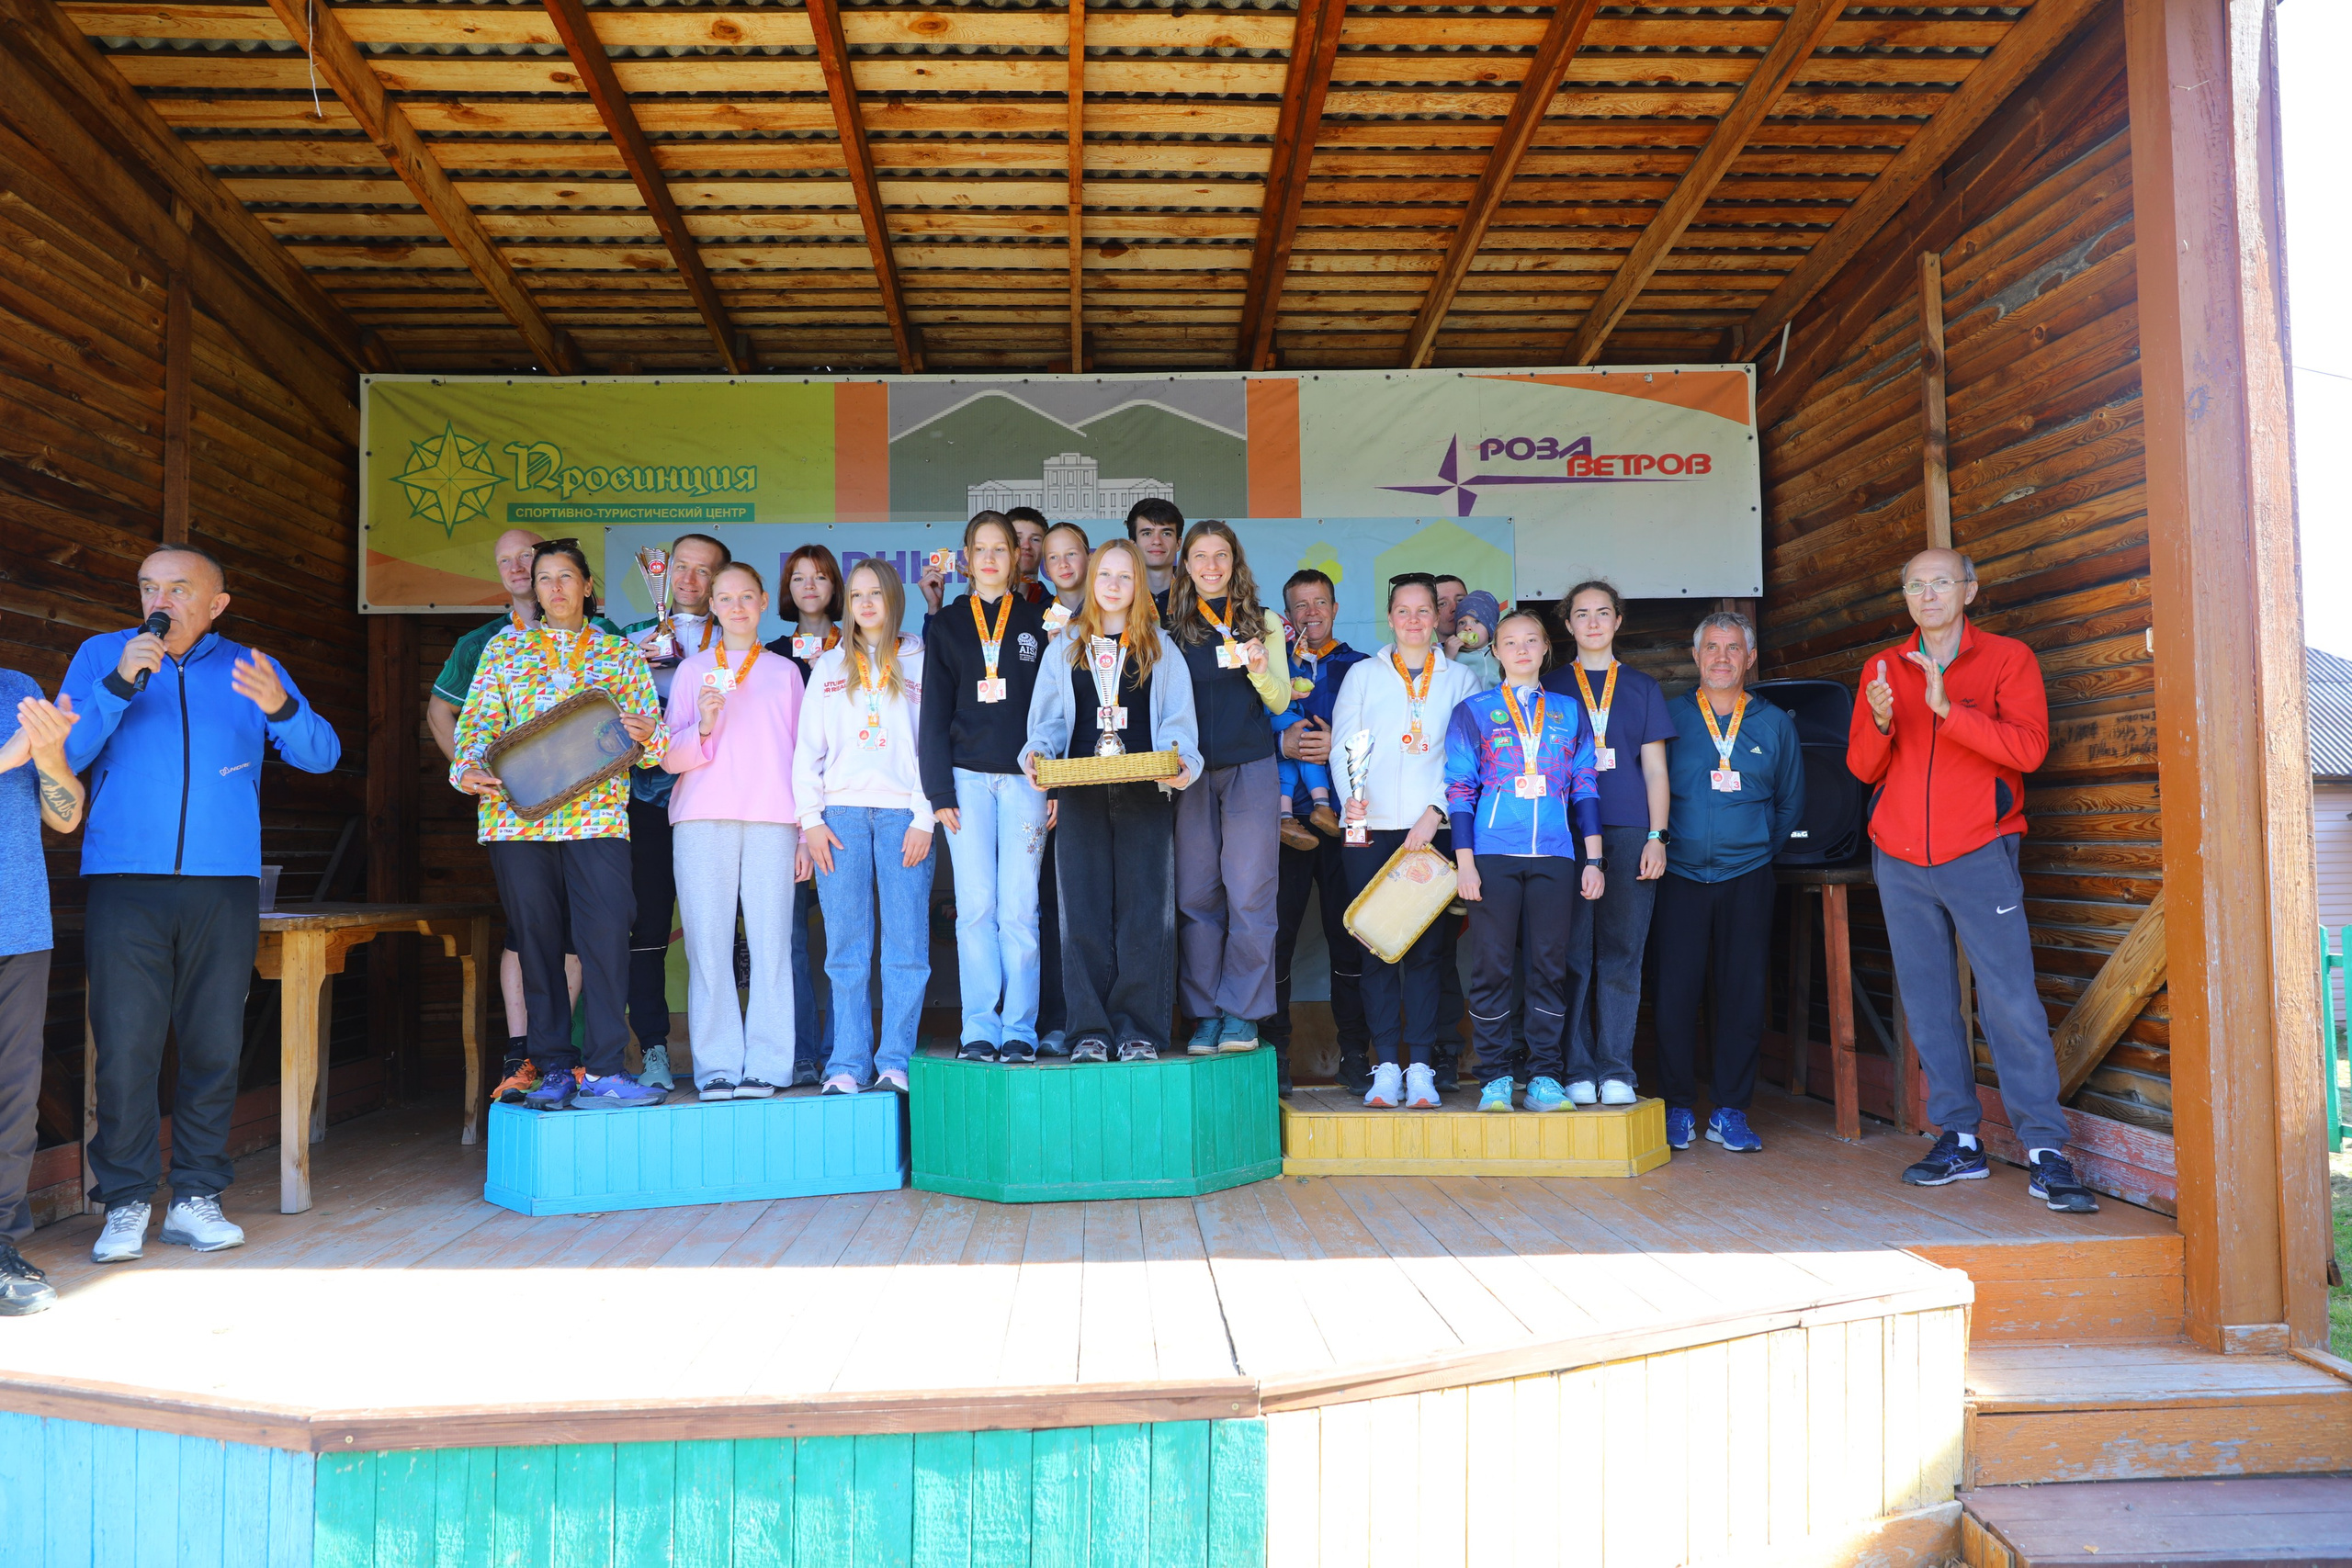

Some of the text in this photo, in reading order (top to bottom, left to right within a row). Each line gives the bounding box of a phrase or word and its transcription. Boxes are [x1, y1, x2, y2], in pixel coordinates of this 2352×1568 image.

[1480, 436, 1592, 461] РОЗА
[1566, 453, 1712, 477] ВЕТРОВ
[503, 441, 757, 502] Провинция
[515, 506, 747, 519] СПОРТИВНО-ТУРИСТИЧЕСКИЙ ЦЕНТР
[728, 679, 735, 688] 2
[878, 739, 887, 747] 2
[1421, 743, 1429, 751] 3
[1608, 759, 1615, 767] 3
[1733, 781, 1740, 789] 3
[1538, 786, 1545, 795] 3
